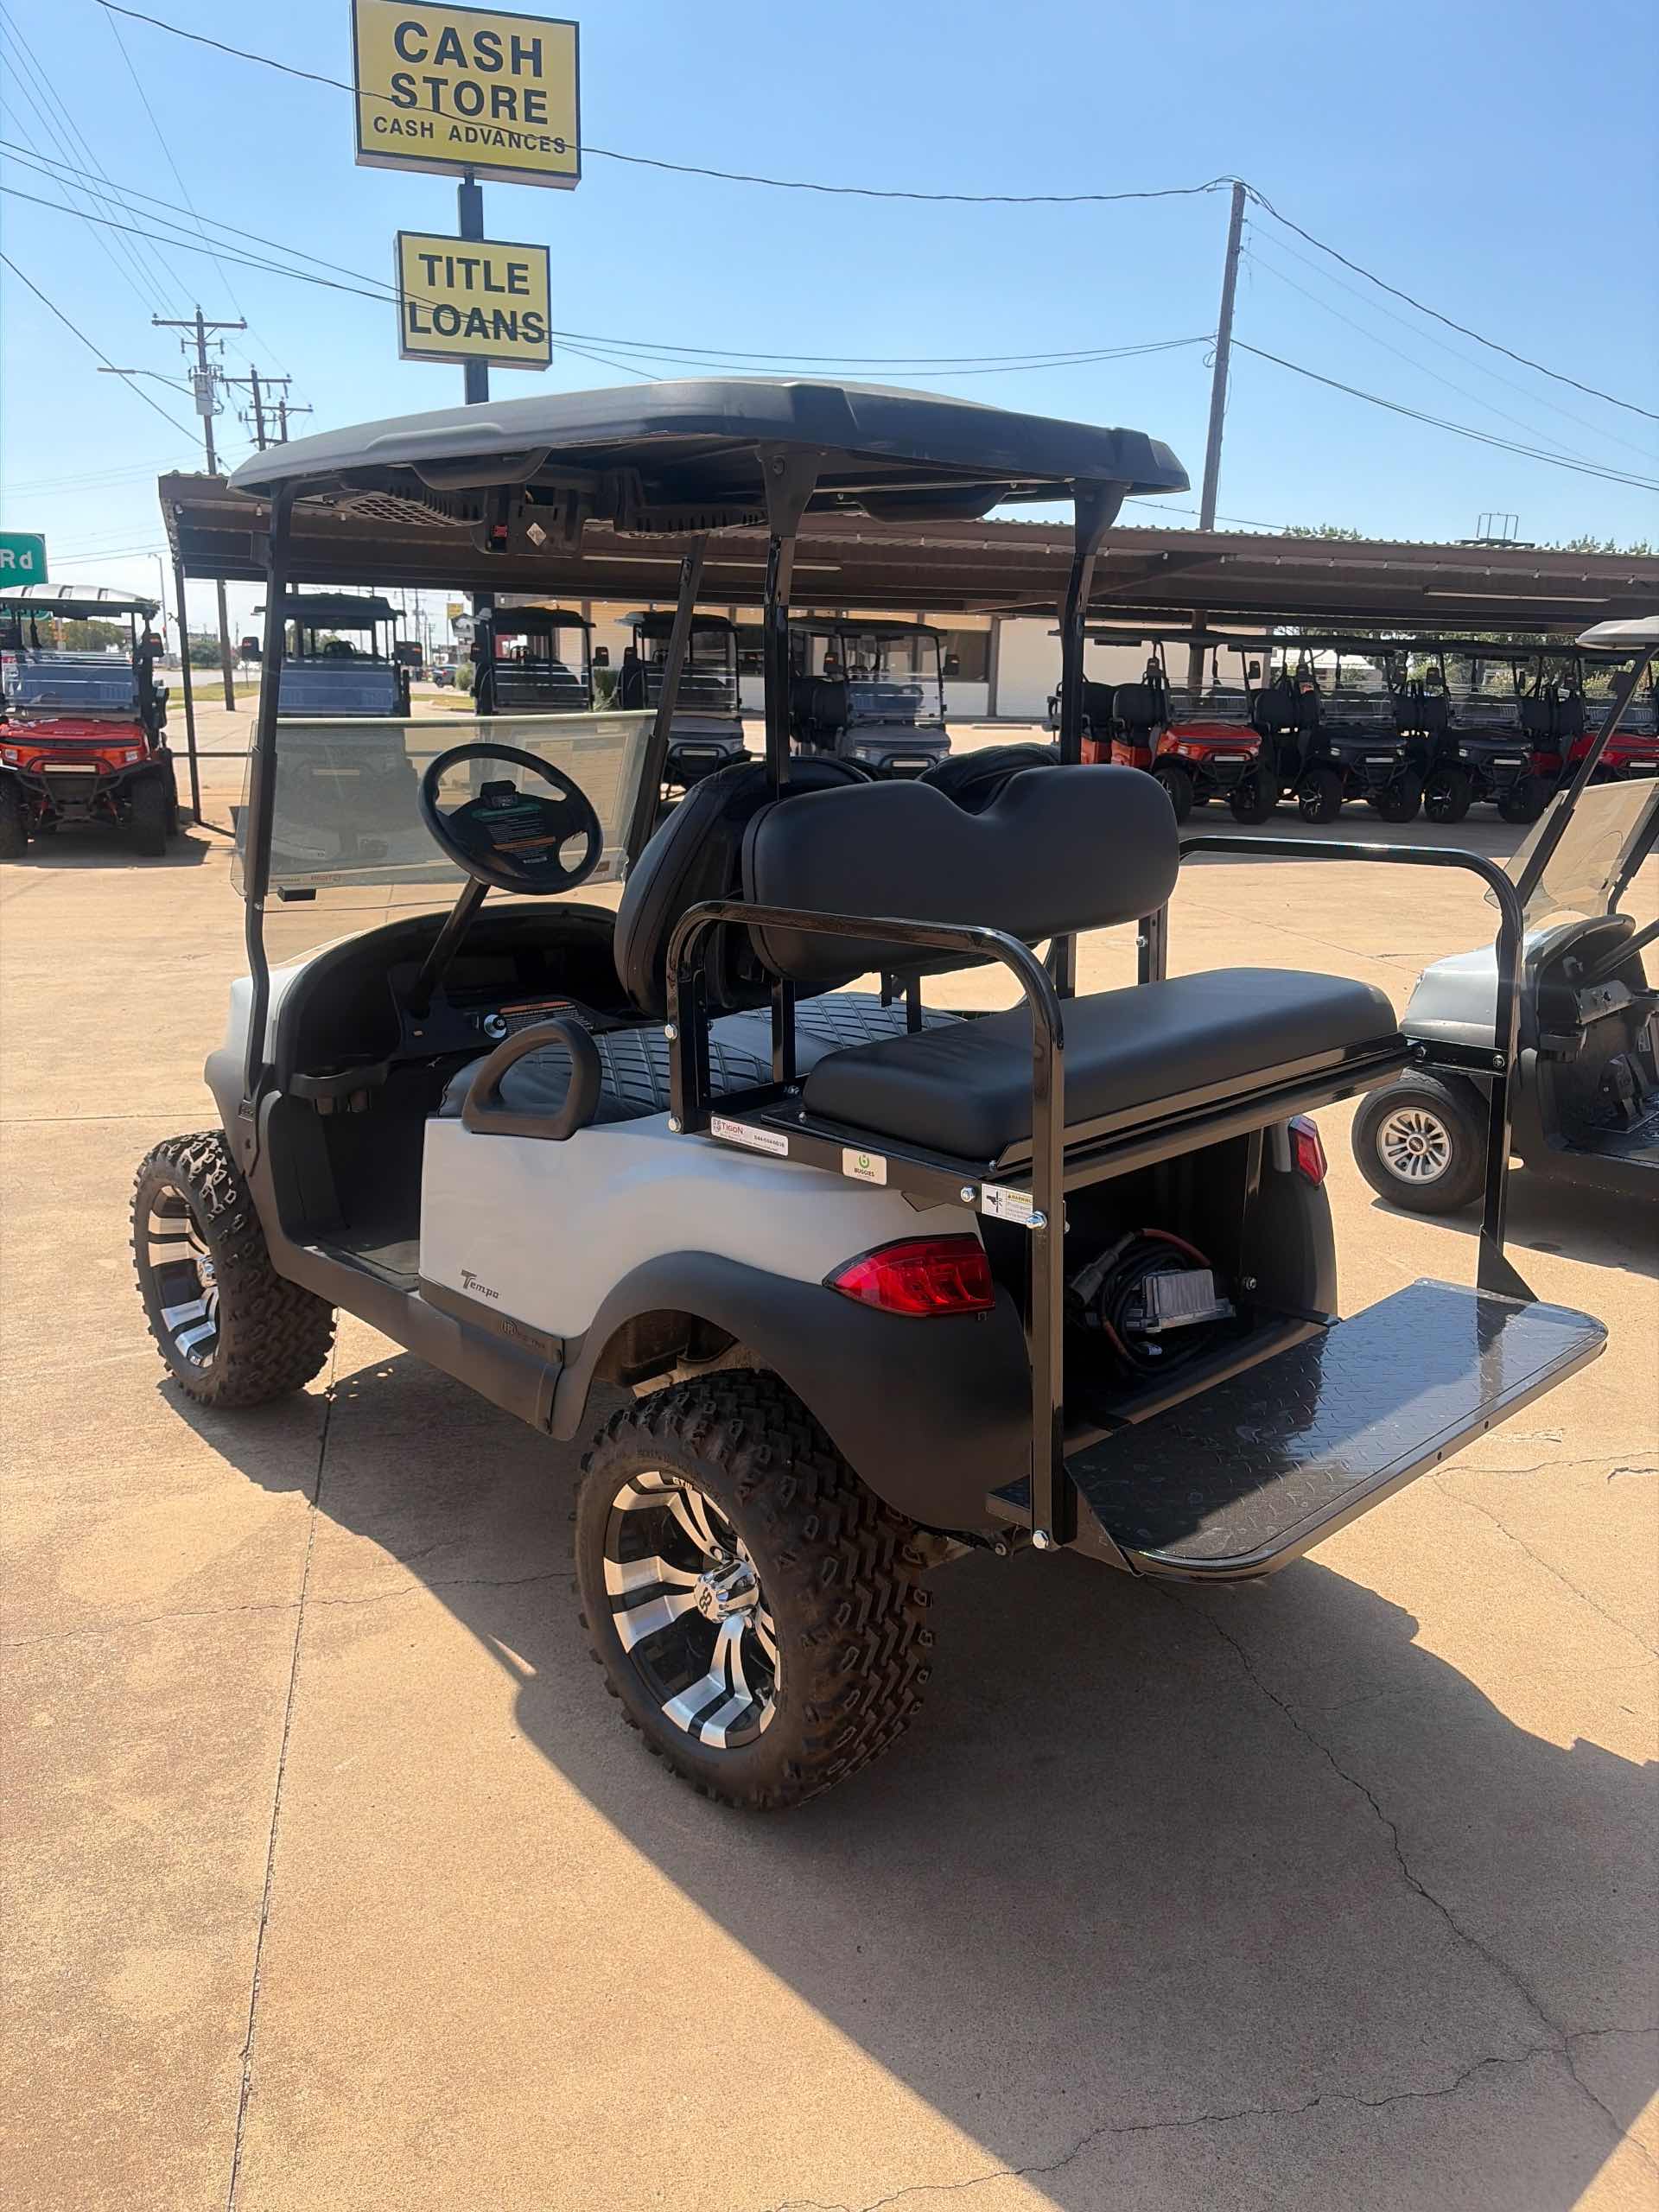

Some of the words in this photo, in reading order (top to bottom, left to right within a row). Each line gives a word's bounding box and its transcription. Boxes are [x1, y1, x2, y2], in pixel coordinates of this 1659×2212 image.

[394, 21, 543, 78] CASH
[391, 73, 549, 124] STORE
[373, 116, 435, 139] CASH
[448, 124, 567, 155] ADVANCES
[418, 253, 531, 296] TITLE
[409, 302, 544, 344] LOANS
[0, 549, 34, 570] Rd
[854, 1167, 875, 1178] BUGGIES
[461, 1268, 499, 1300] Tempo
